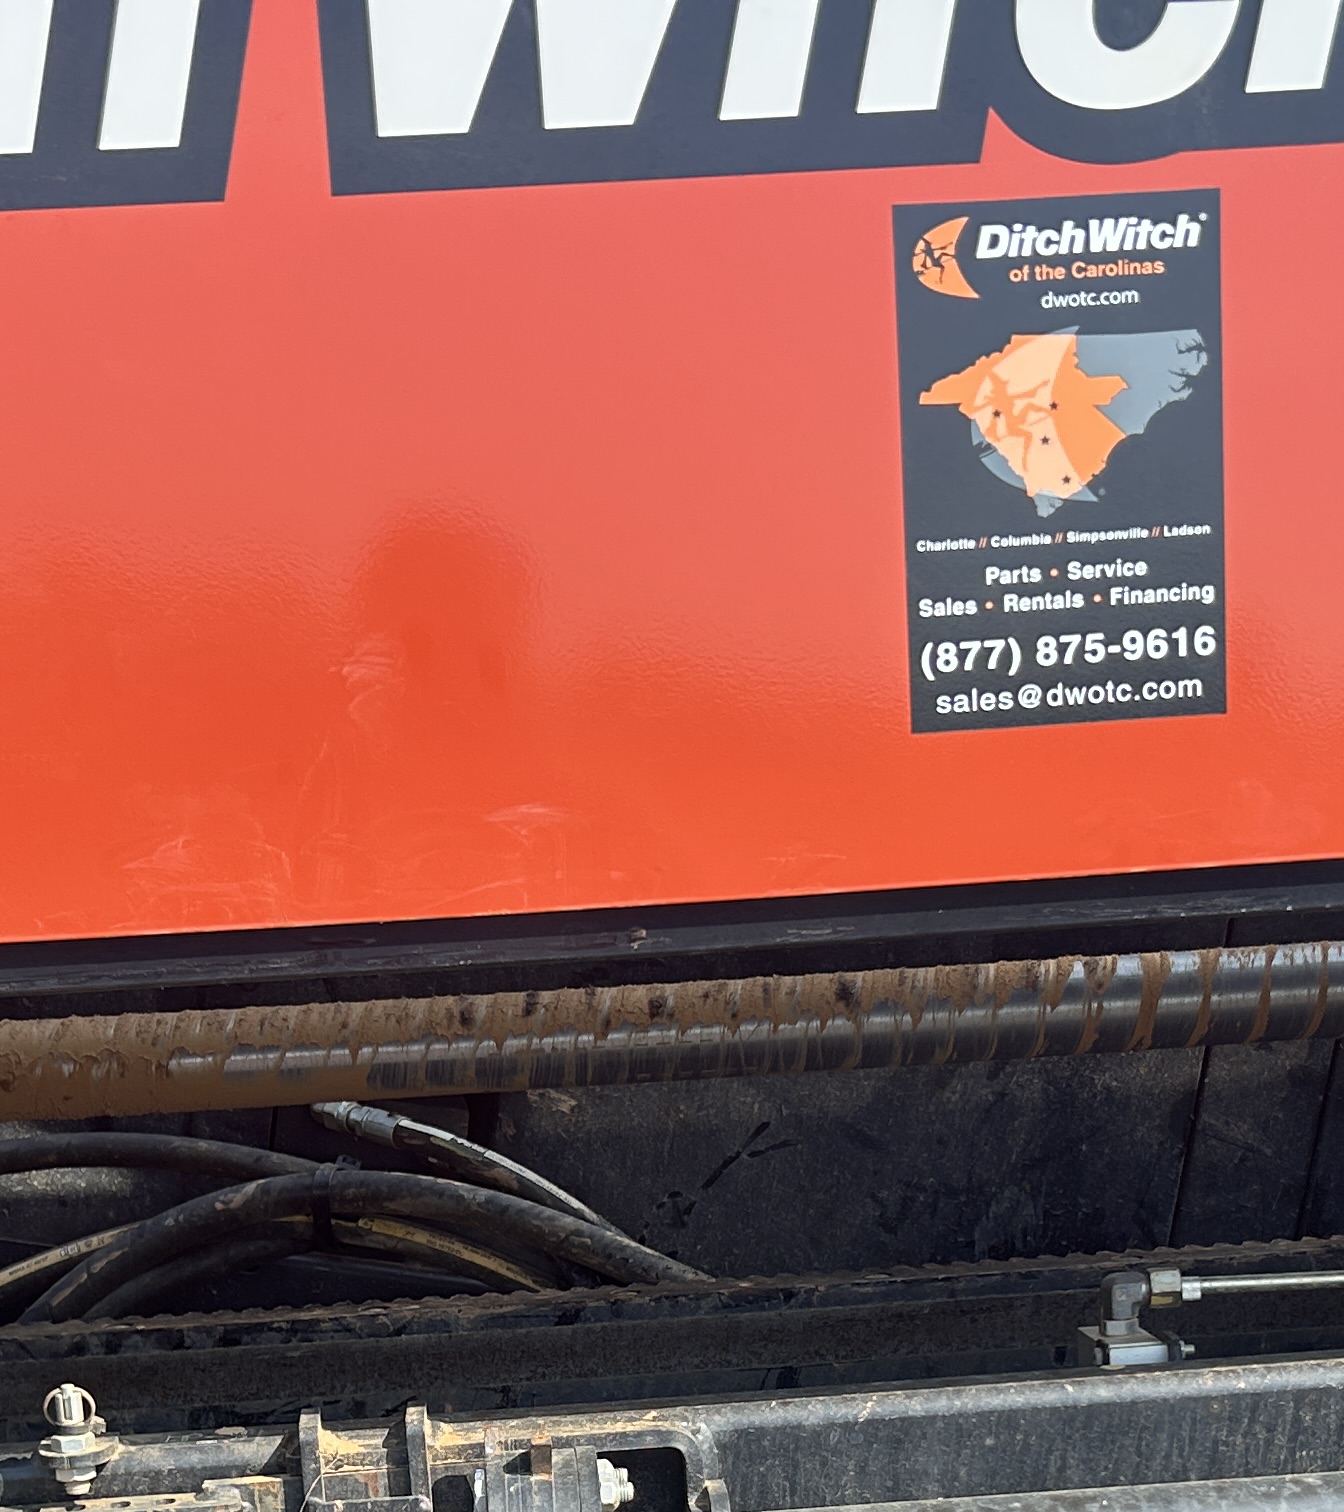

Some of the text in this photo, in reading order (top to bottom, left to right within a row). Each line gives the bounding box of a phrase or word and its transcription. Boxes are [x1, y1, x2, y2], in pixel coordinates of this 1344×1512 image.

[1010, 259, 1165, 282] of the Carolinas
[1041, 289, 1139, 309] dwotc.com
[916, 537, 975, 553] Charlotte
[991, 534, 1052, 549] Columbia
[1066, 527, 1148, 544] Simpsonville
[1163, 523, 1211, 537] Ladson
[986, 559, 1147, 586] Parts Service
[919, 583, 1214, 618] Sales Rentals Financing
[920, 625, 1216, 681] (877) 875-9616
[936, 679, 1202, 714] sales@dwotc.com
